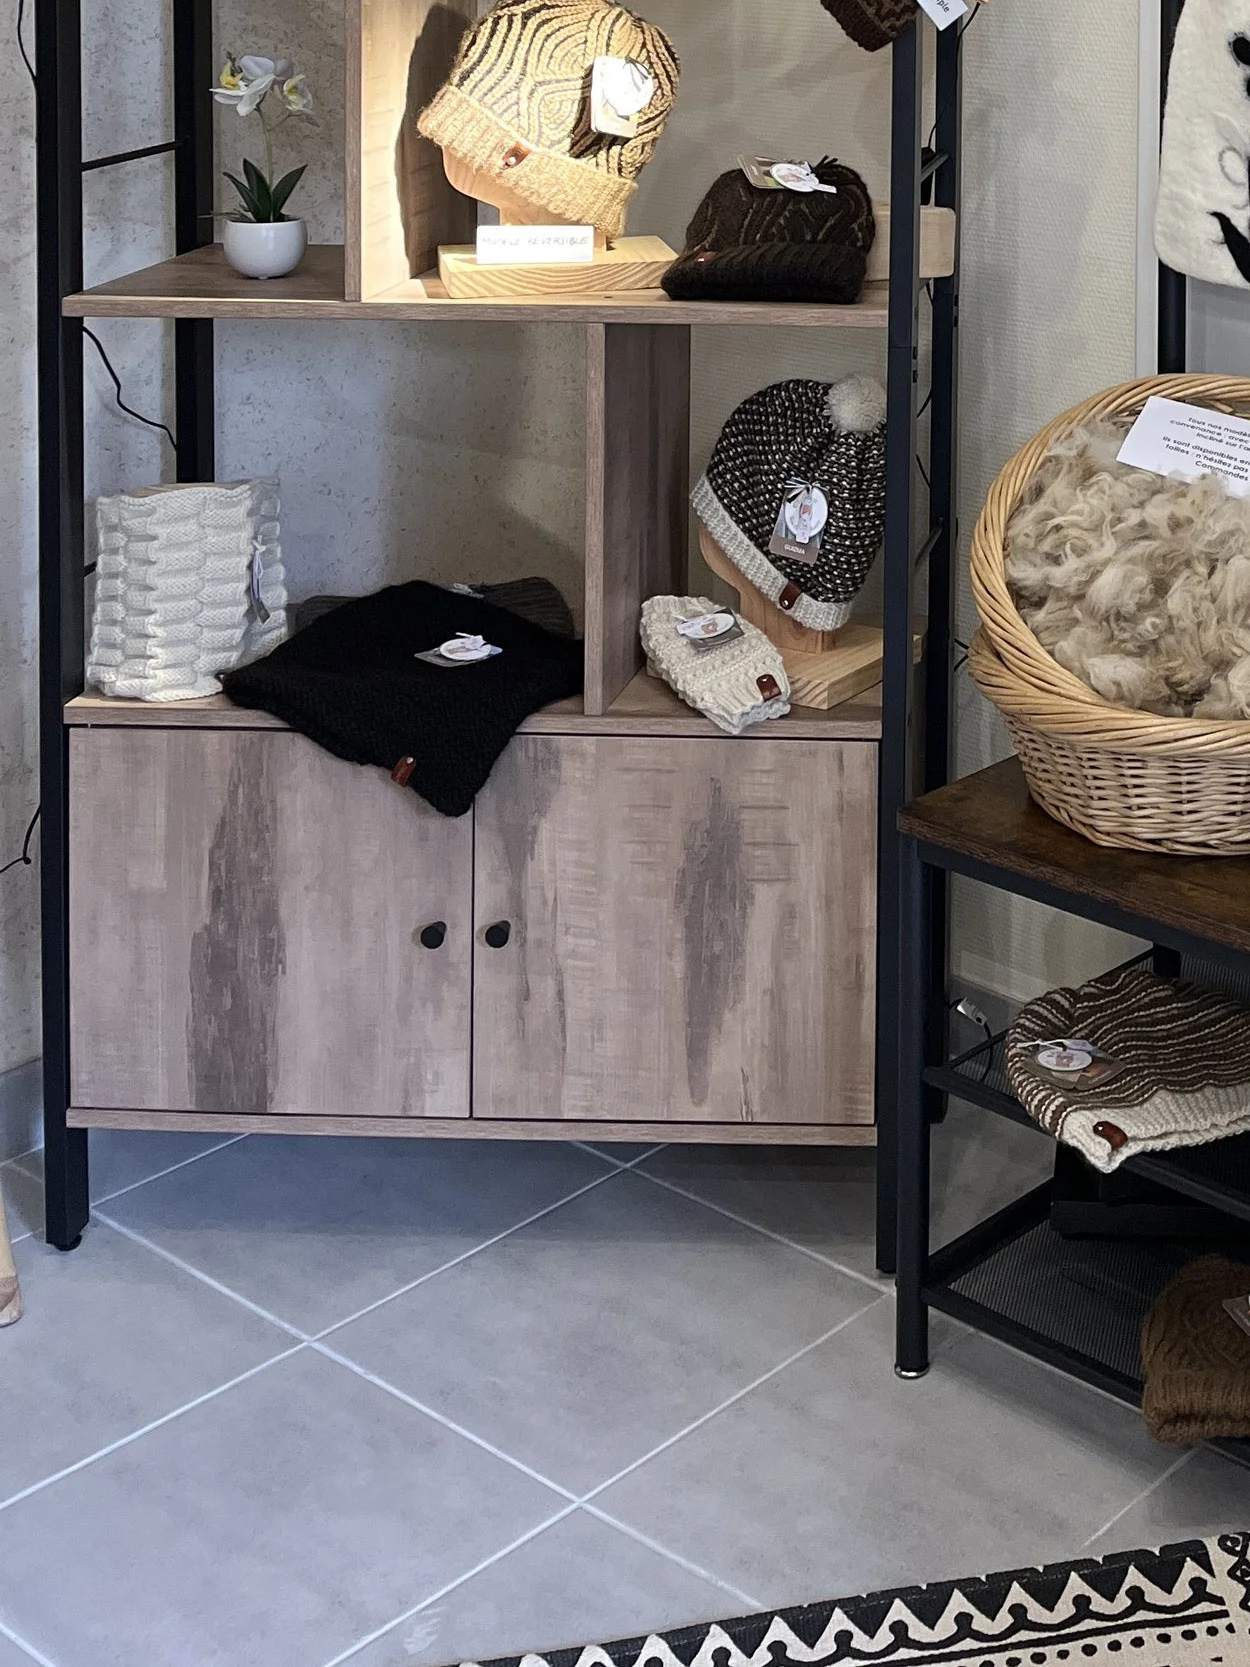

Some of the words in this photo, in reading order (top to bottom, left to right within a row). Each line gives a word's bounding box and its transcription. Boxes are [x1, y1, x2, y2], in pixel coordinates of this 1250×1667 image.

[1170, 420, 1222, 436] convenance
[1228, 436, 1250, 444] avec
[1189, 418, 1206, 426] Tous
[1173, 440, 1191, 448] sont
[1192, 445, 1238, 462] disponibles
[1195, 461, 1248, 481] Commandes
[1233, 465, 1248, 473] pas
